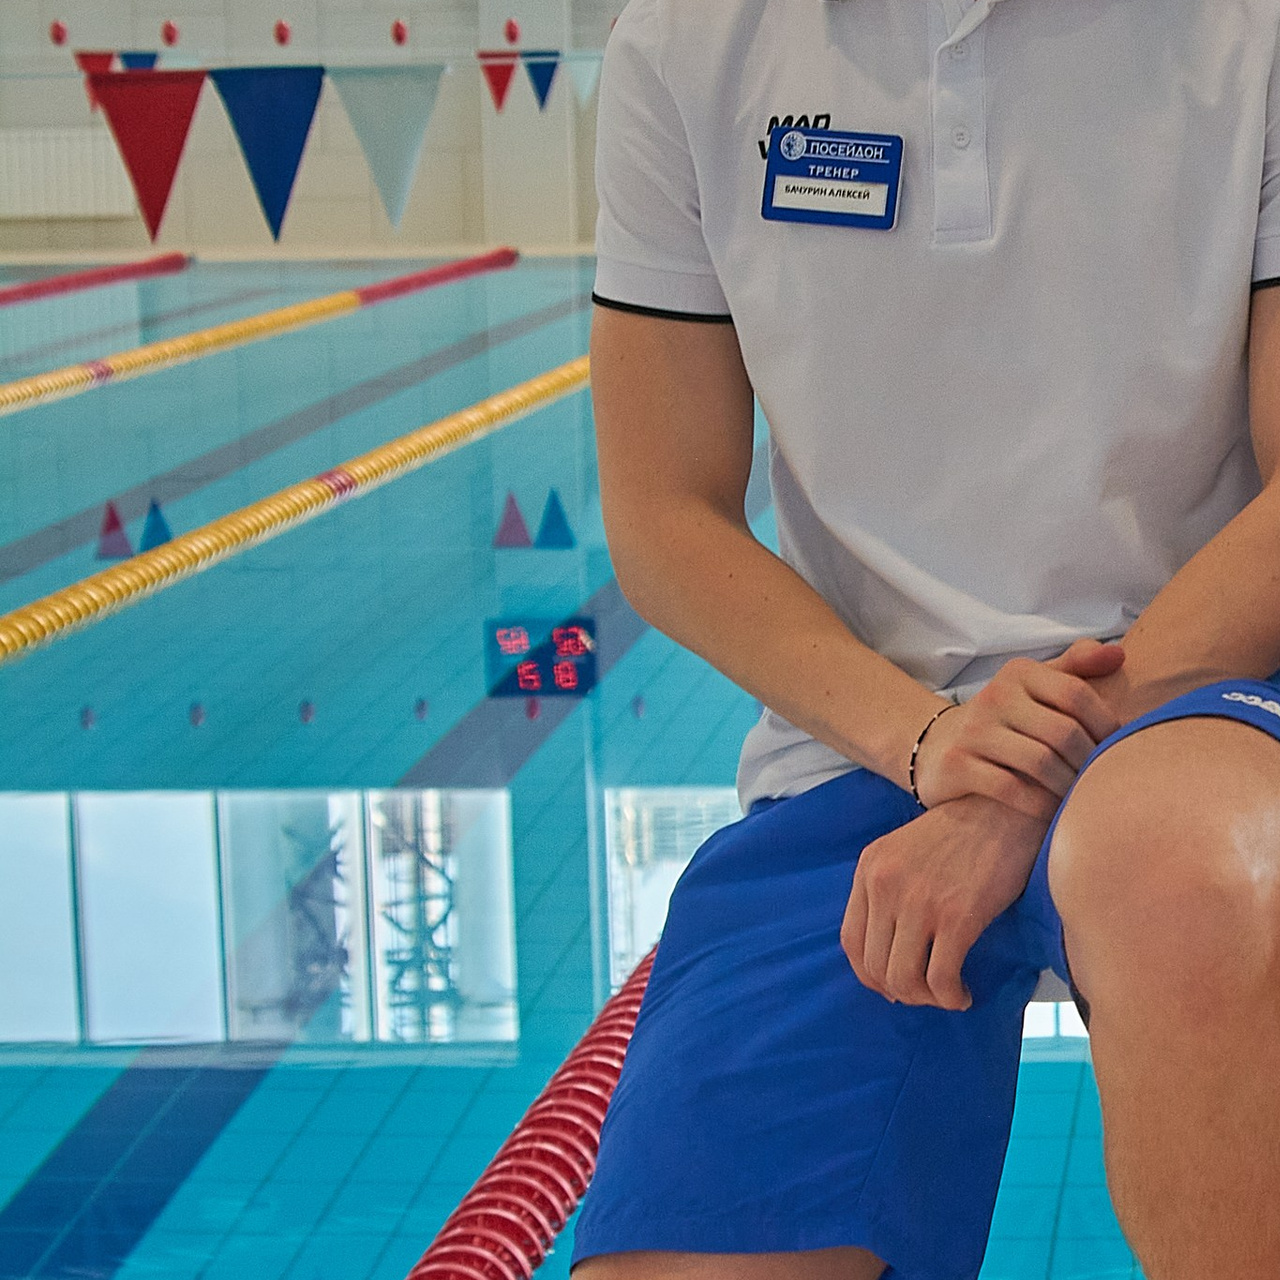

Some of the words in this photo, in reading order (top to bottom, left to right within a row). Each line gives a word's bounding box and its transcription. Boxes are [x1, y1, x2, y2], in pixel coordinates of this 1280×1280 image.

[810, 142, 883, 159] ПОСЕЙДОН
[808, 164, 859, 179] ТРЕНЕР
[785, 184, 827, 197] БАЧУРИН
[828, 186, 870, 200] АЛЕКСЕЙ
